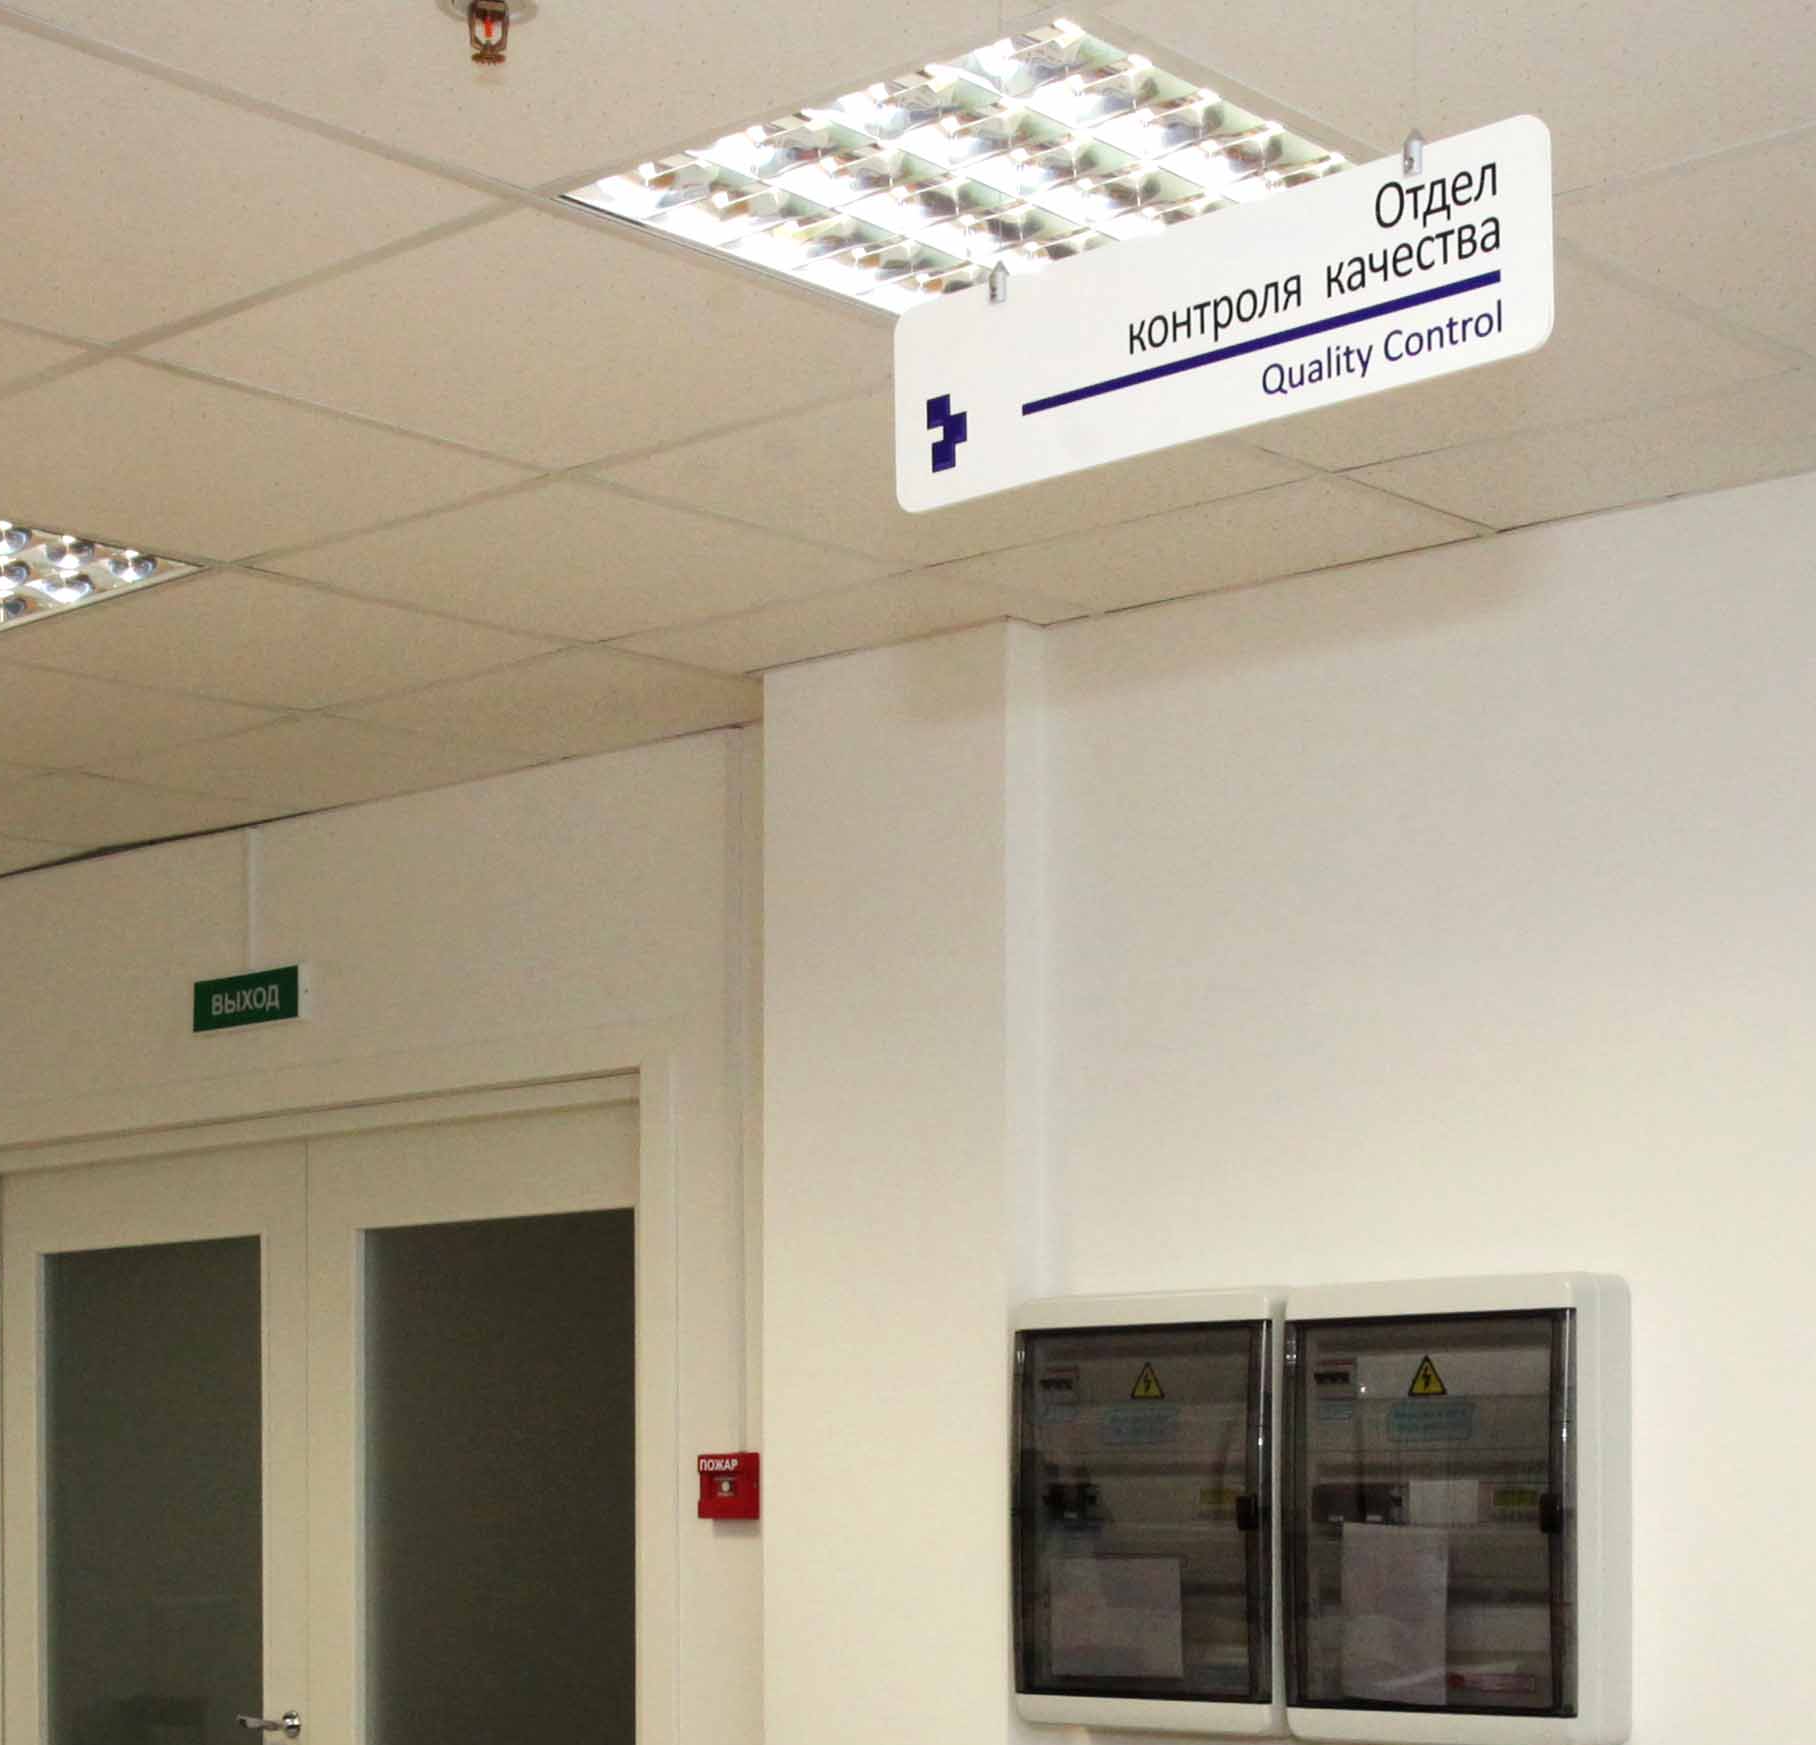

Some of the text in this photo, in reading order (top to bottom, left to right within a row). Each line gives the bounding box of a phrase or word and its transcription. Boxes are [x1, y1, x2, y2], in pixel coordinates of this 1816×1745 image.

[1374, 161, 1499, 229] Отдел
[1127, 216, 1502, 356] контроля качества
[1261, 300, 1504, 396] Quality Control
[210, 984, 280, 1016] ВЫХОД
[699, 1458, 739, 1471] ПОЖАР
